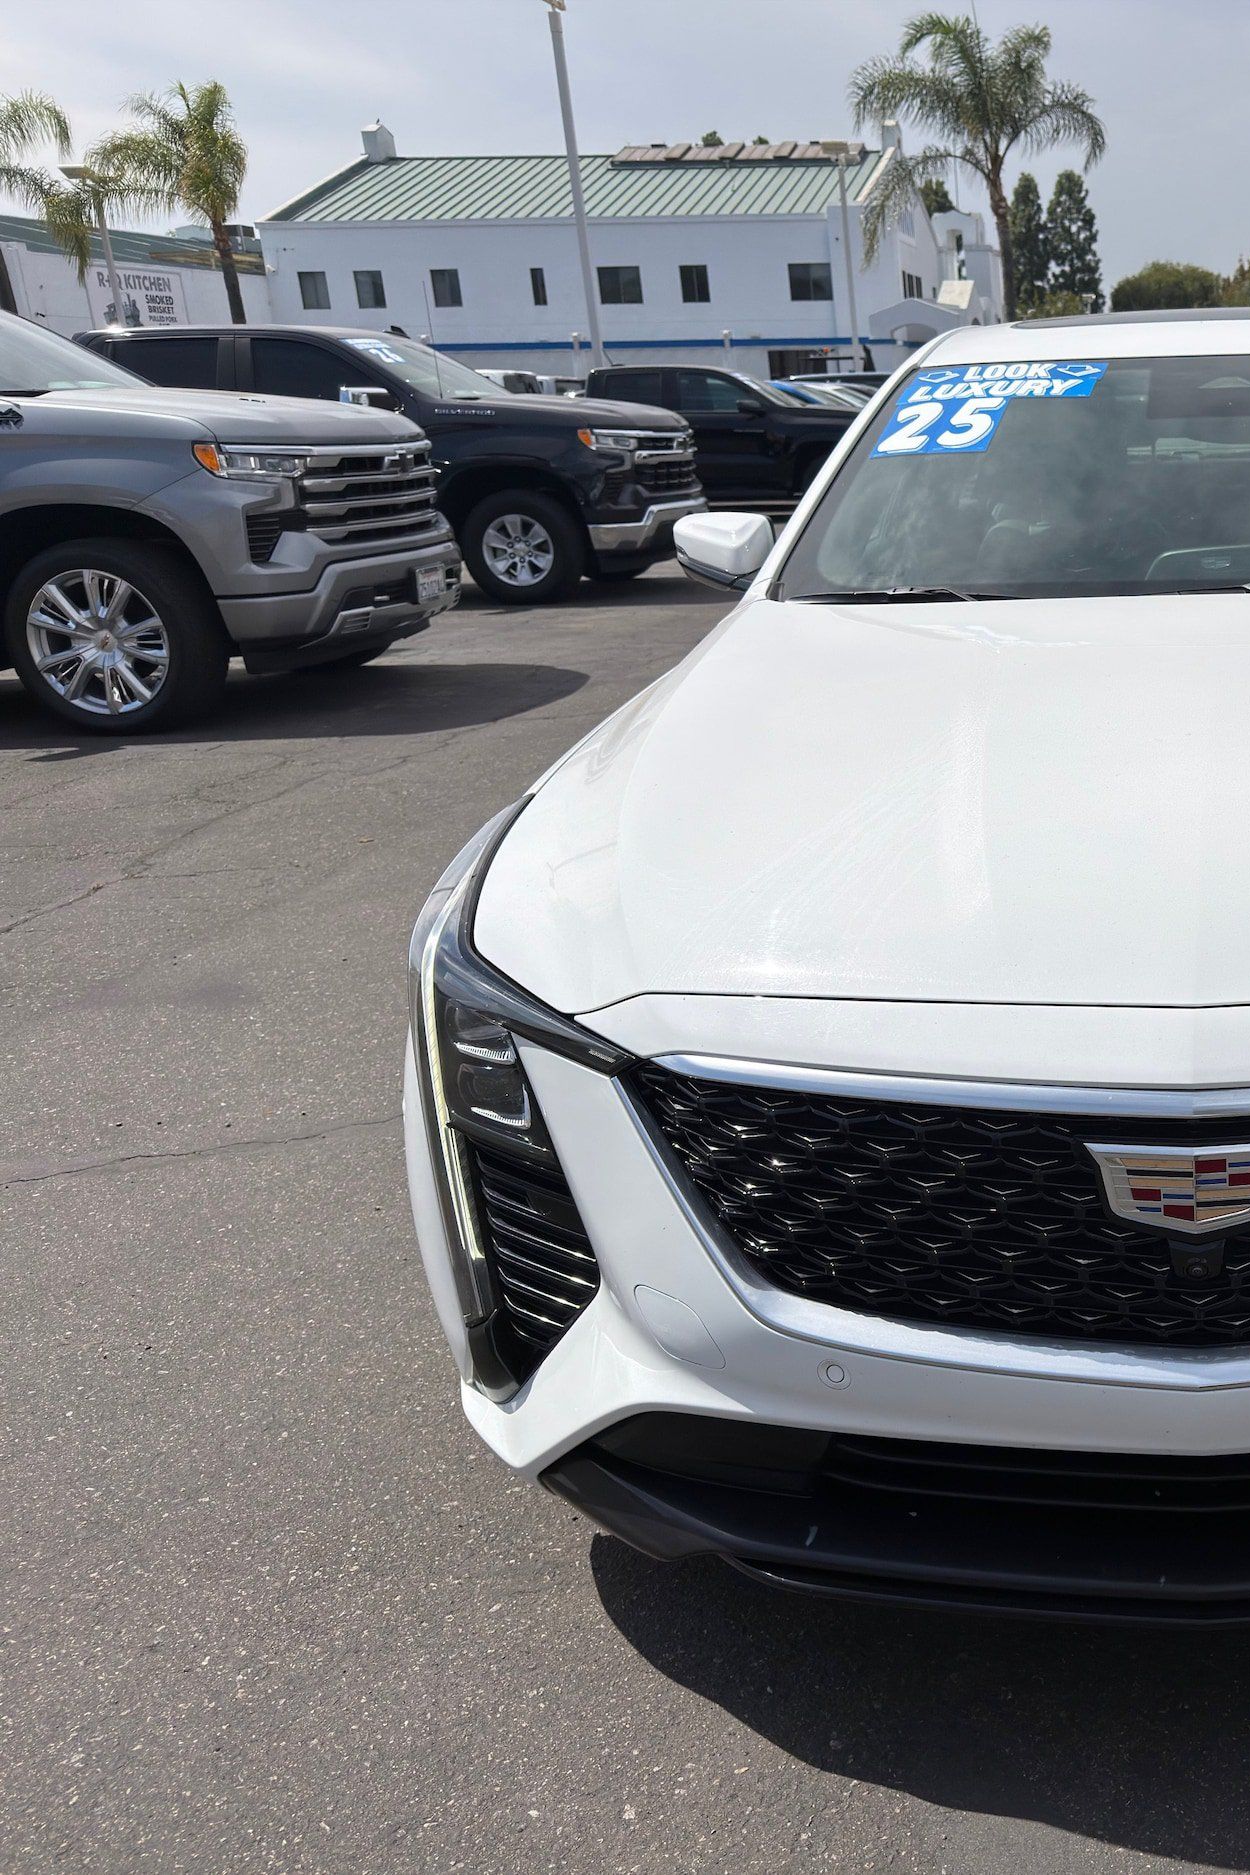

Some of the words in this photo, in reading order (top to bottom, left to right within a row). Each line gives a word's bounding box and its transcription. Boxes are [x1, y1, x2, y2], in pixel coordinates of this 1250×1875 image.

[124, 273, 172, 292] KITCHEN
[145, 294, 174, 305] SMOKED
[148, 305, 174, 315] BRISKET
[963, 363, 1058, 381] LOOK
[908, 379, 1083, 402] LUXURY
[877, 397, 1006, 454] 25
